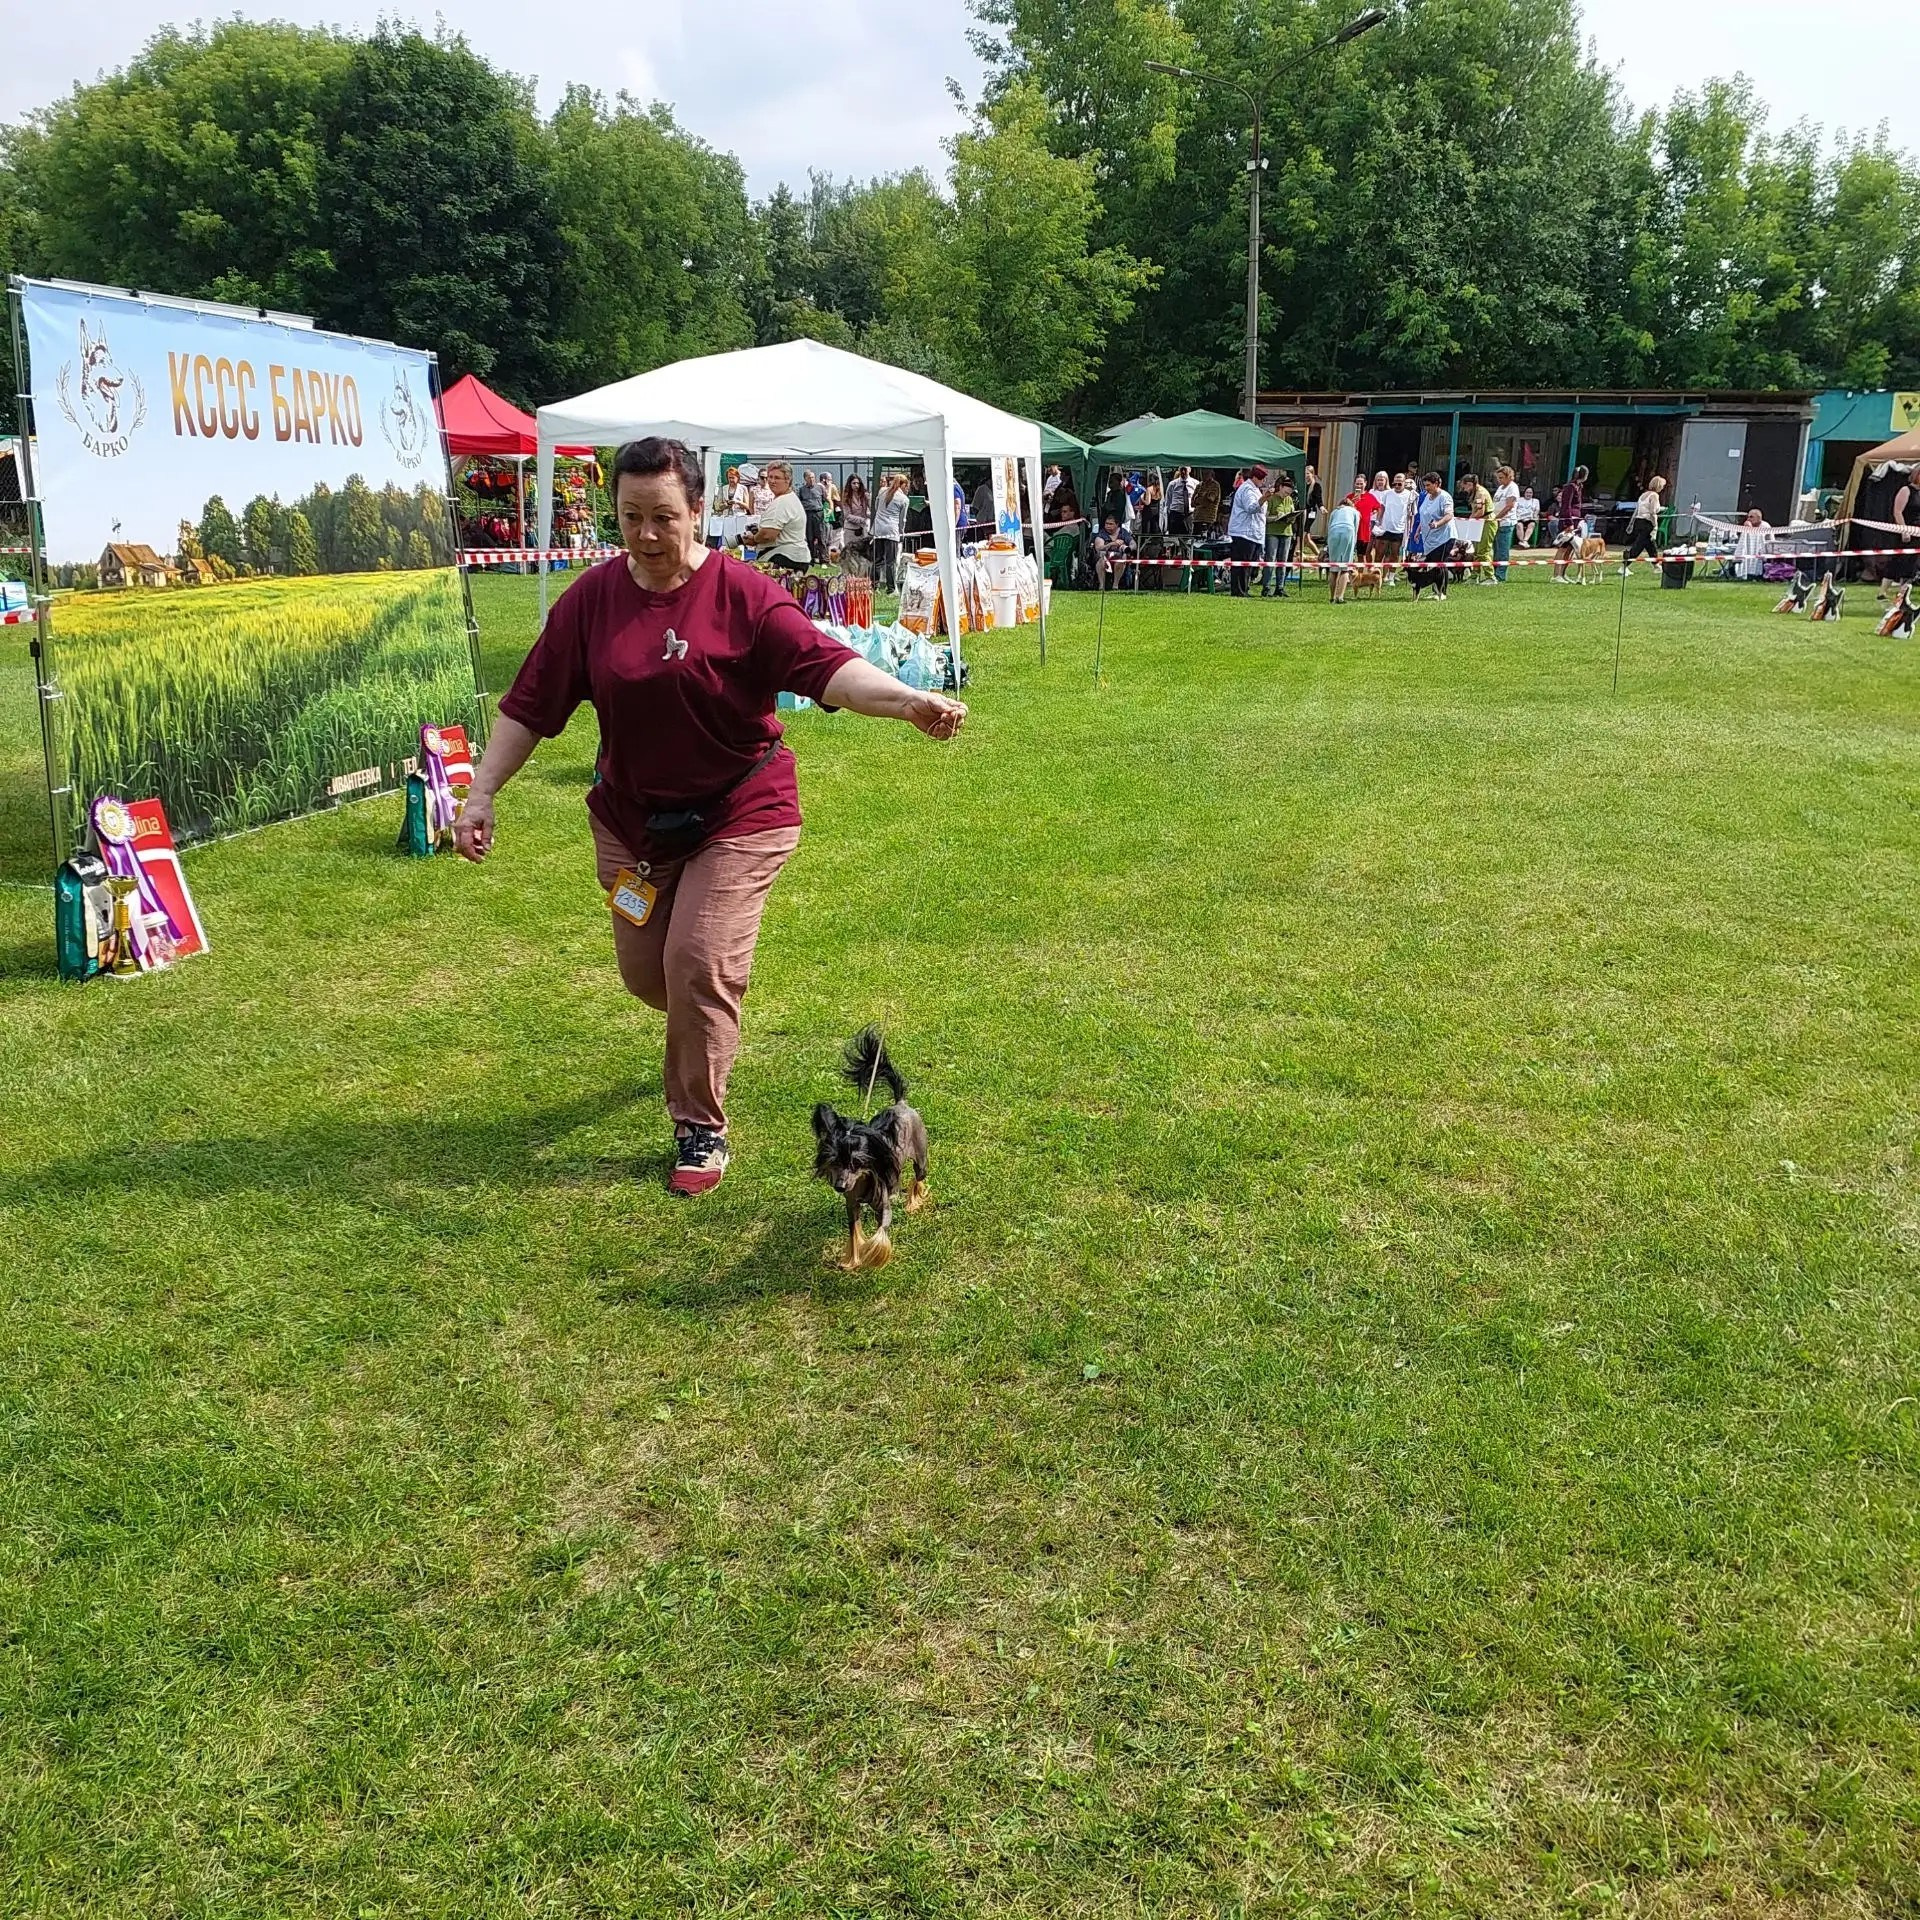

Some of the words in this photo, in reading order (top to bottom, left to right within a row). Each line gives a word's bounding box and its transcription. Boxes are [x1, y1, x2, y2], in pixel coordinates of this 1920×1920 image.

[168, 351, 260, 440] КССС
[269, 364, 363, 447] БАРКО
[82, 431, 129, 458] БАРКО
